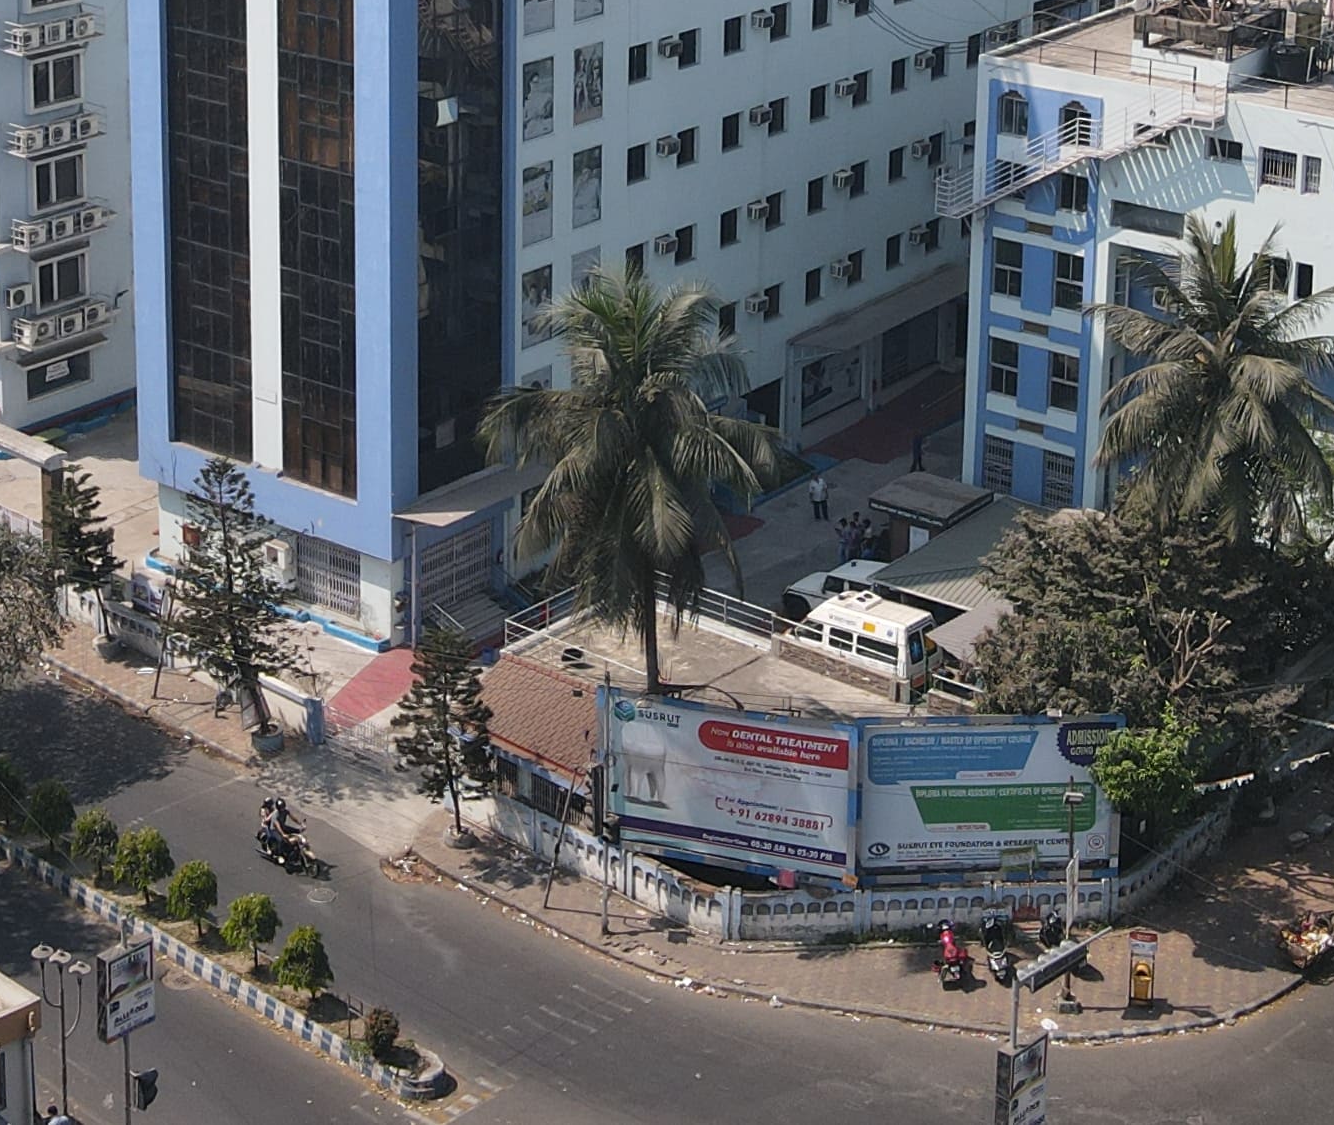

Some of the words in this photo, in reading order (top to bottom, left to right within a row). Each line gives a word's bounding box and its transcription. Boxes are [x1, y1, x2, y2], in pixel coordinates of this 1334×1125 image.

[638, 709, 681, 724] SUSRUT
[732, 729, 773, 743] DENTAL
[775, 736, 839, 753] TREATMENT
